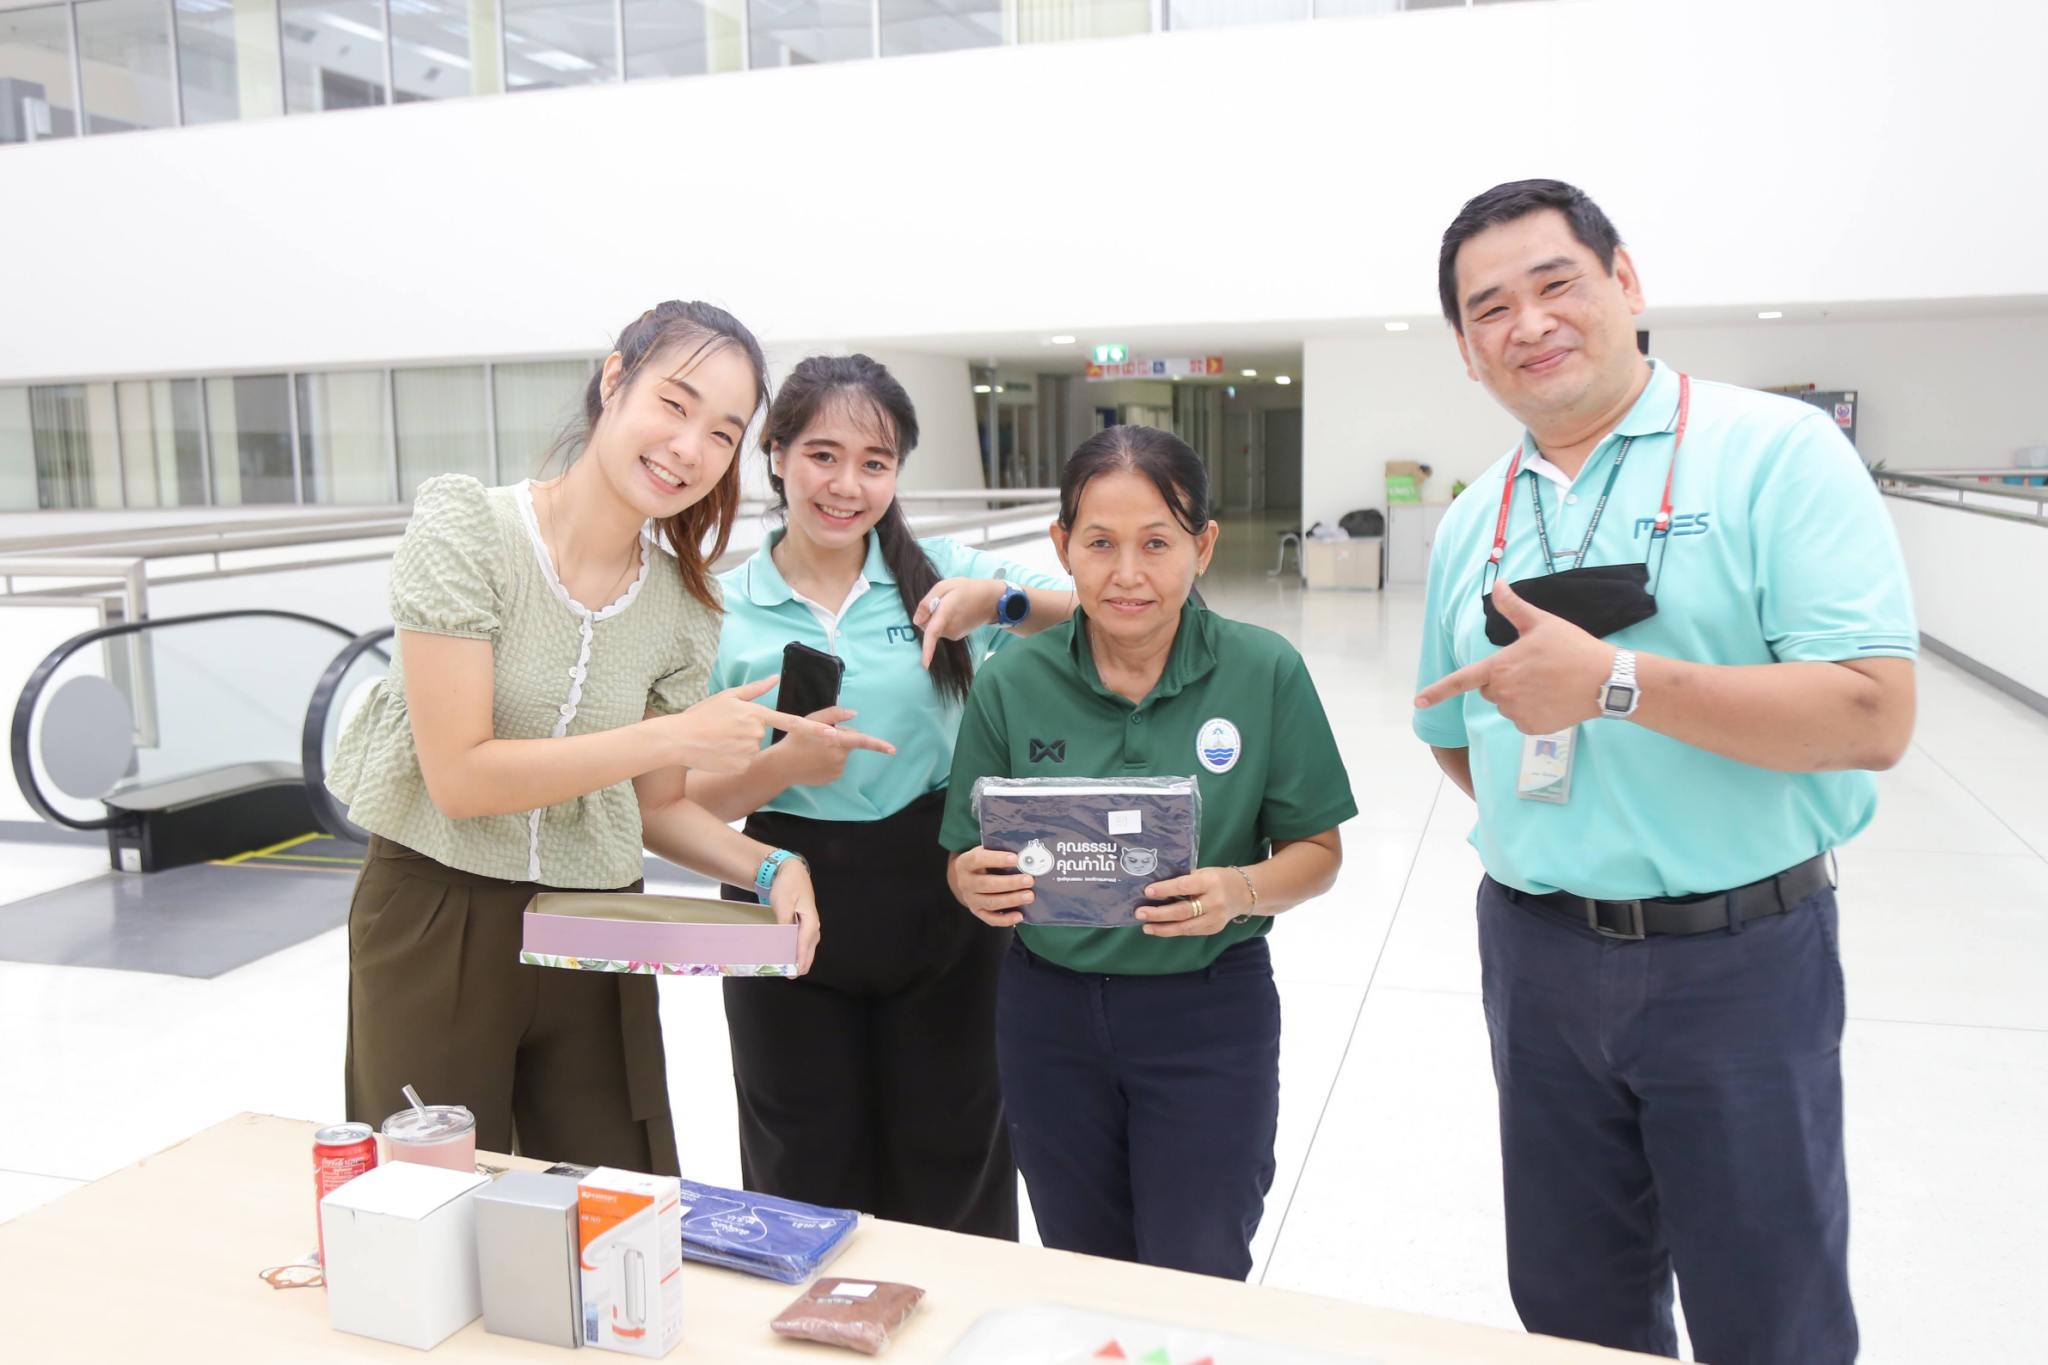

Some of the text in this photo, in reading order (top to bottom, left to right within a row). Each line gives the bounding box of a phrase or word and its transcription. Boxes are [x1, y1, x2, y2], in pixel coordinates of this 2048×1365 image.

[1056, 841, 1118, 856] คุณธรรม
[1056, 854, 1118, 875] คุณทำได้
